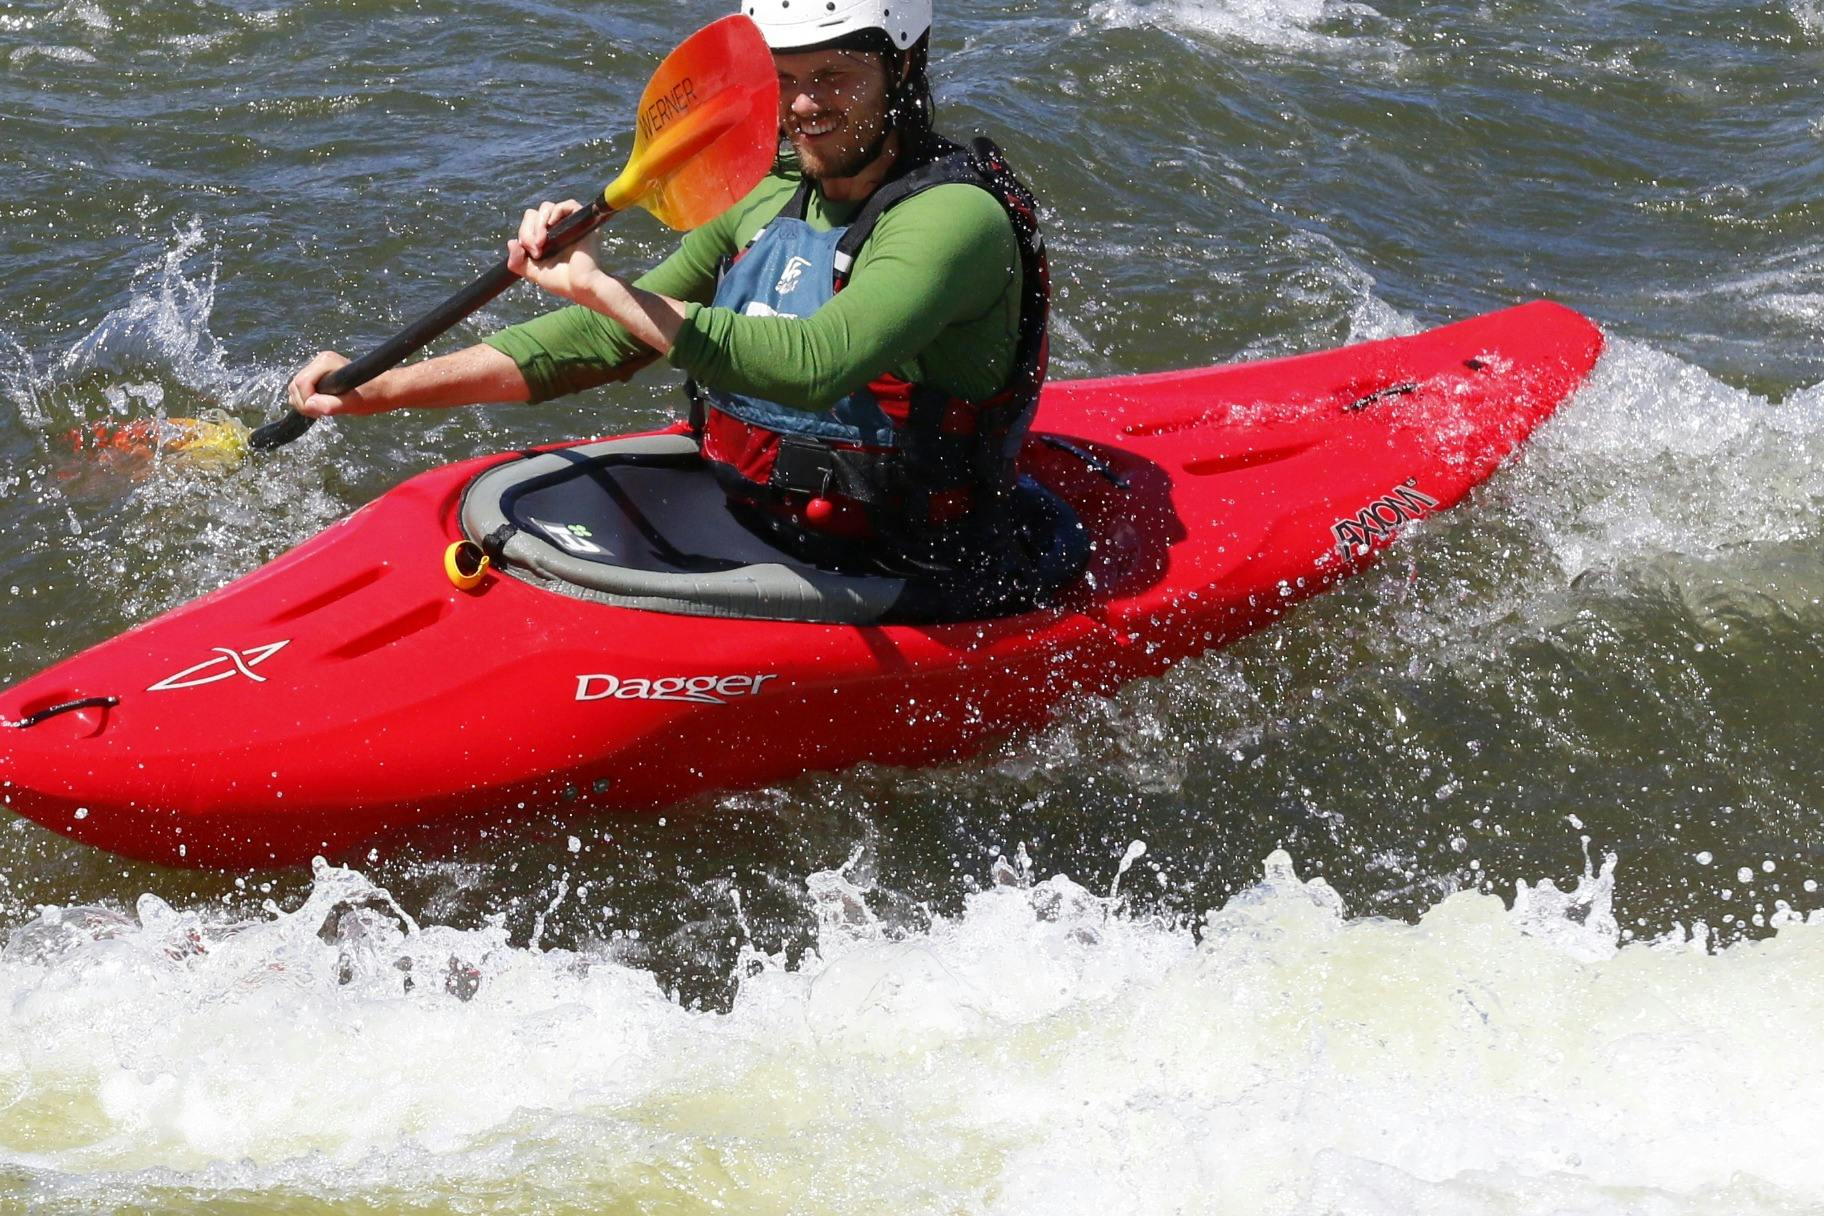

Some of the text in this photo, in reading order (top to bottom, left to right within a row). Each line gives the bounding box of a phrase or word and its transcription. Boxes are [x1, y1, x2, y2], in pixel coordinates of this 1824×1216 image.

[639, 78, 697, 140] WERNER
[1331, 485, 1439, 563] AXIOM
[576, 673, 778, 704] Dagger
